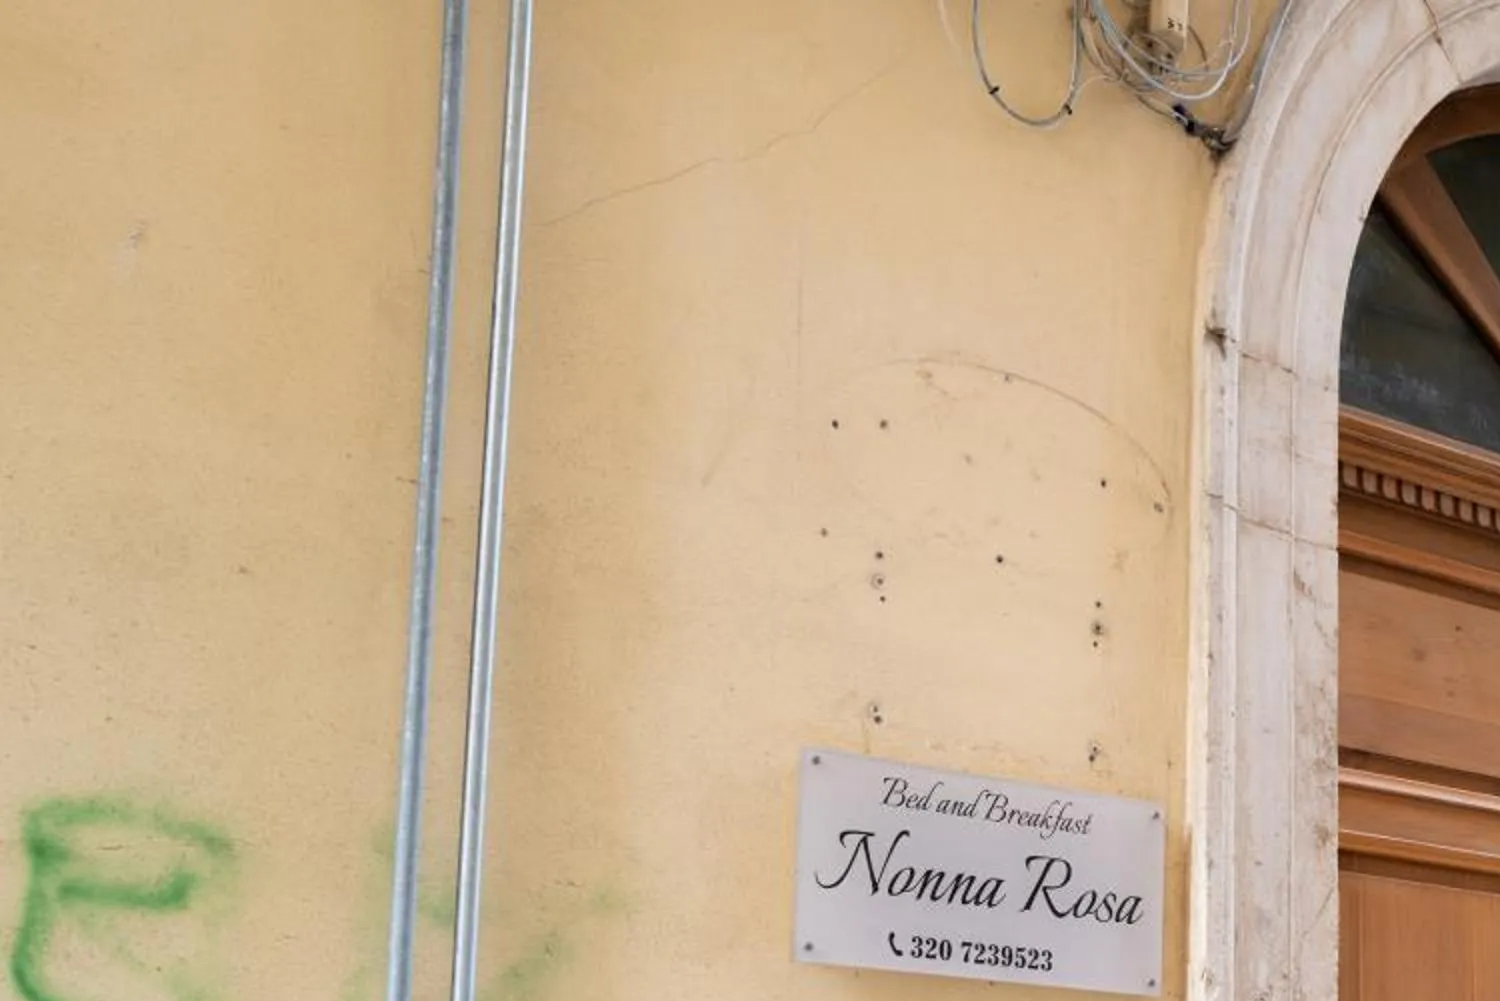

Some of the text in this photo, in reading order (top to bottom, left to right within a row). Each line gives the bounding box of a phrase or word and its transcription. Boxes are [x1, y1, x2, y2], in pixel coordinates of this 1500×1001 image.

[883, 777, 1093, 841] Bed and Breakfast
[815, 829, 1145, 925] Nonna Rosa
[910, 936, 1053, 971] 320 7239523
